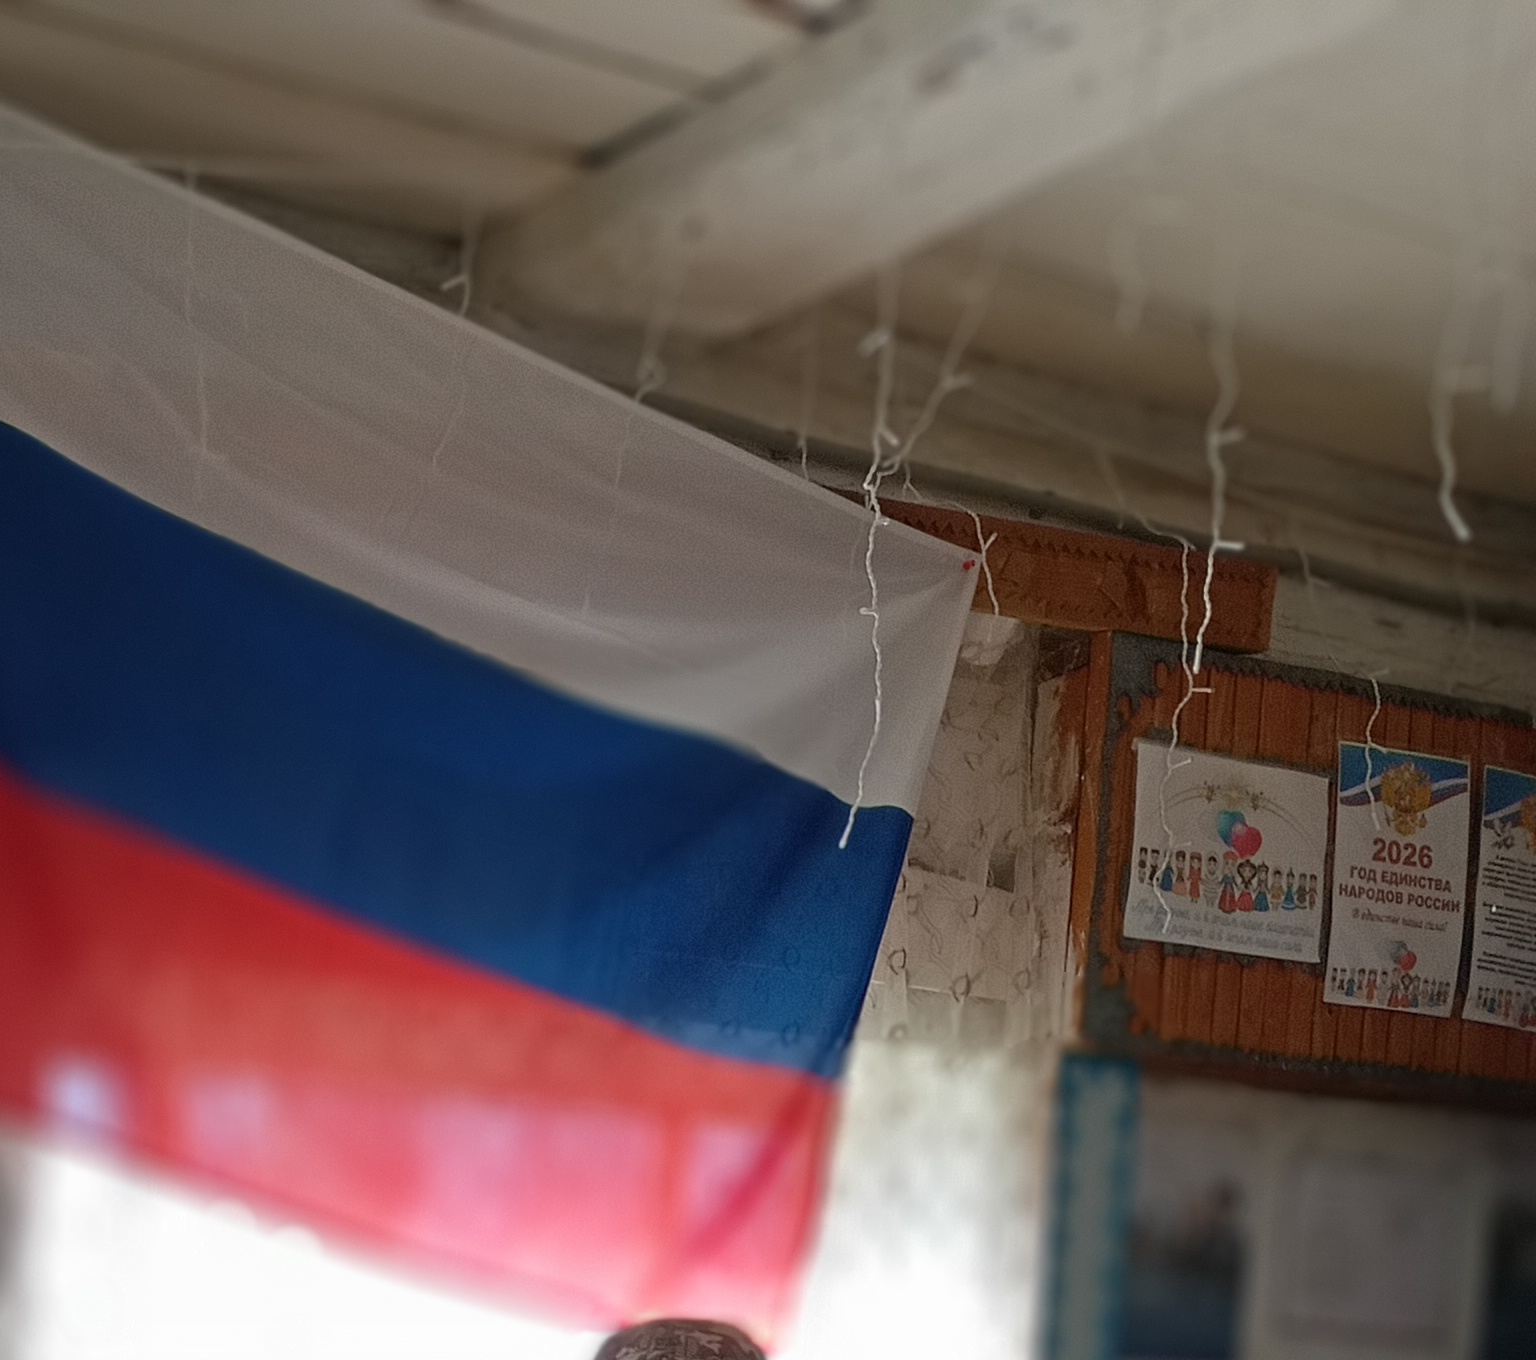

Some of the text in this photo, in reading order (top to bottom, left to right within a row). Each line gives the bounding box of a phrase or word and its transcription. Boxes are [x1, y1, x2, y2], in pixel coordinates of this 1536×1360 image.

[1373, 837, 1433, 869] 2026
[1350, 866, 1451, 893] ГОД ЕДИНСТВА
[1339, 883, 1460, 913] НАРОДОВ РОССИИ
